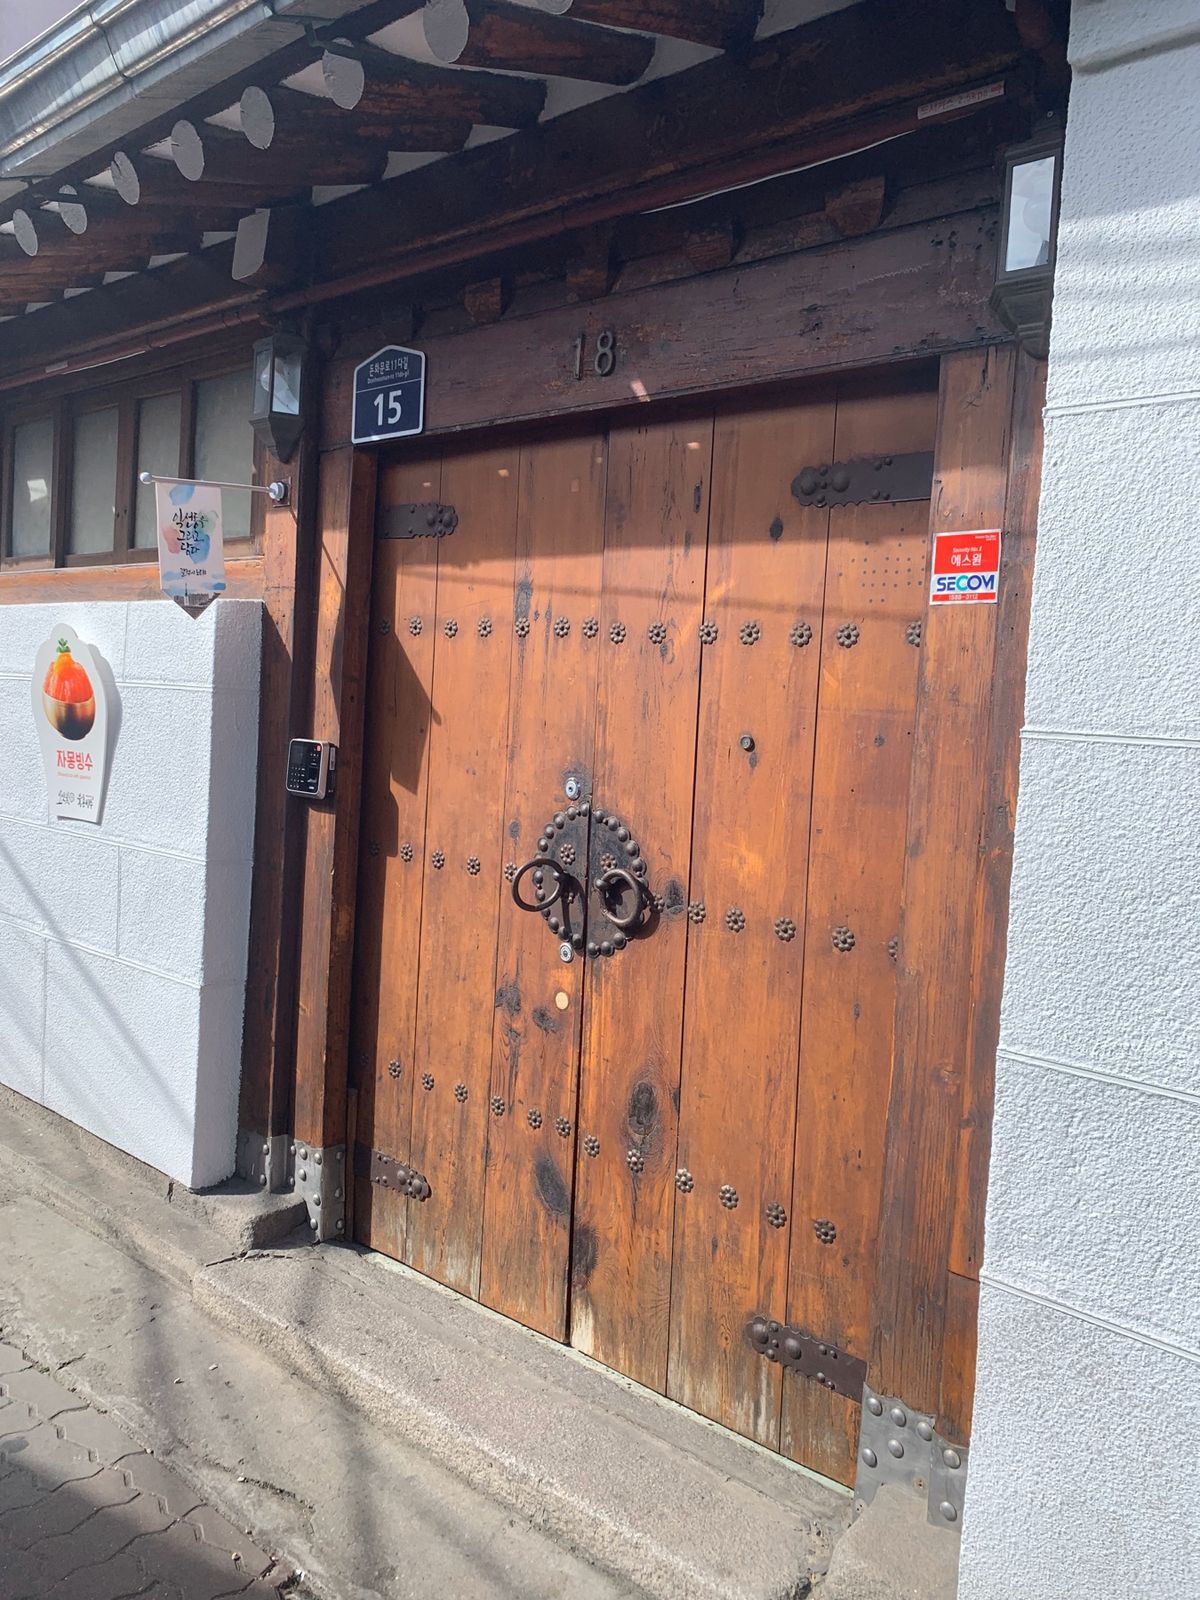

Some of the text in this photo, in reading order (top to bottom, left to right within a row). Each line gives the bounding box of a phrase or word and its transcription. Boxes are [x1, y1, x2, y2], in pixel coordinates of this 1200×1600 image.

[572, 331, 613, 379] 18
[373, 389, 403, 426] 15
[177, 530, 205, 542] 그리고
[180, 542, 200, 556] 담다
[950, 553, 982, 567] 에스원
[936, 575, 995, 592] SECOM
[56, 750, 94, 771] 자몽빙수
